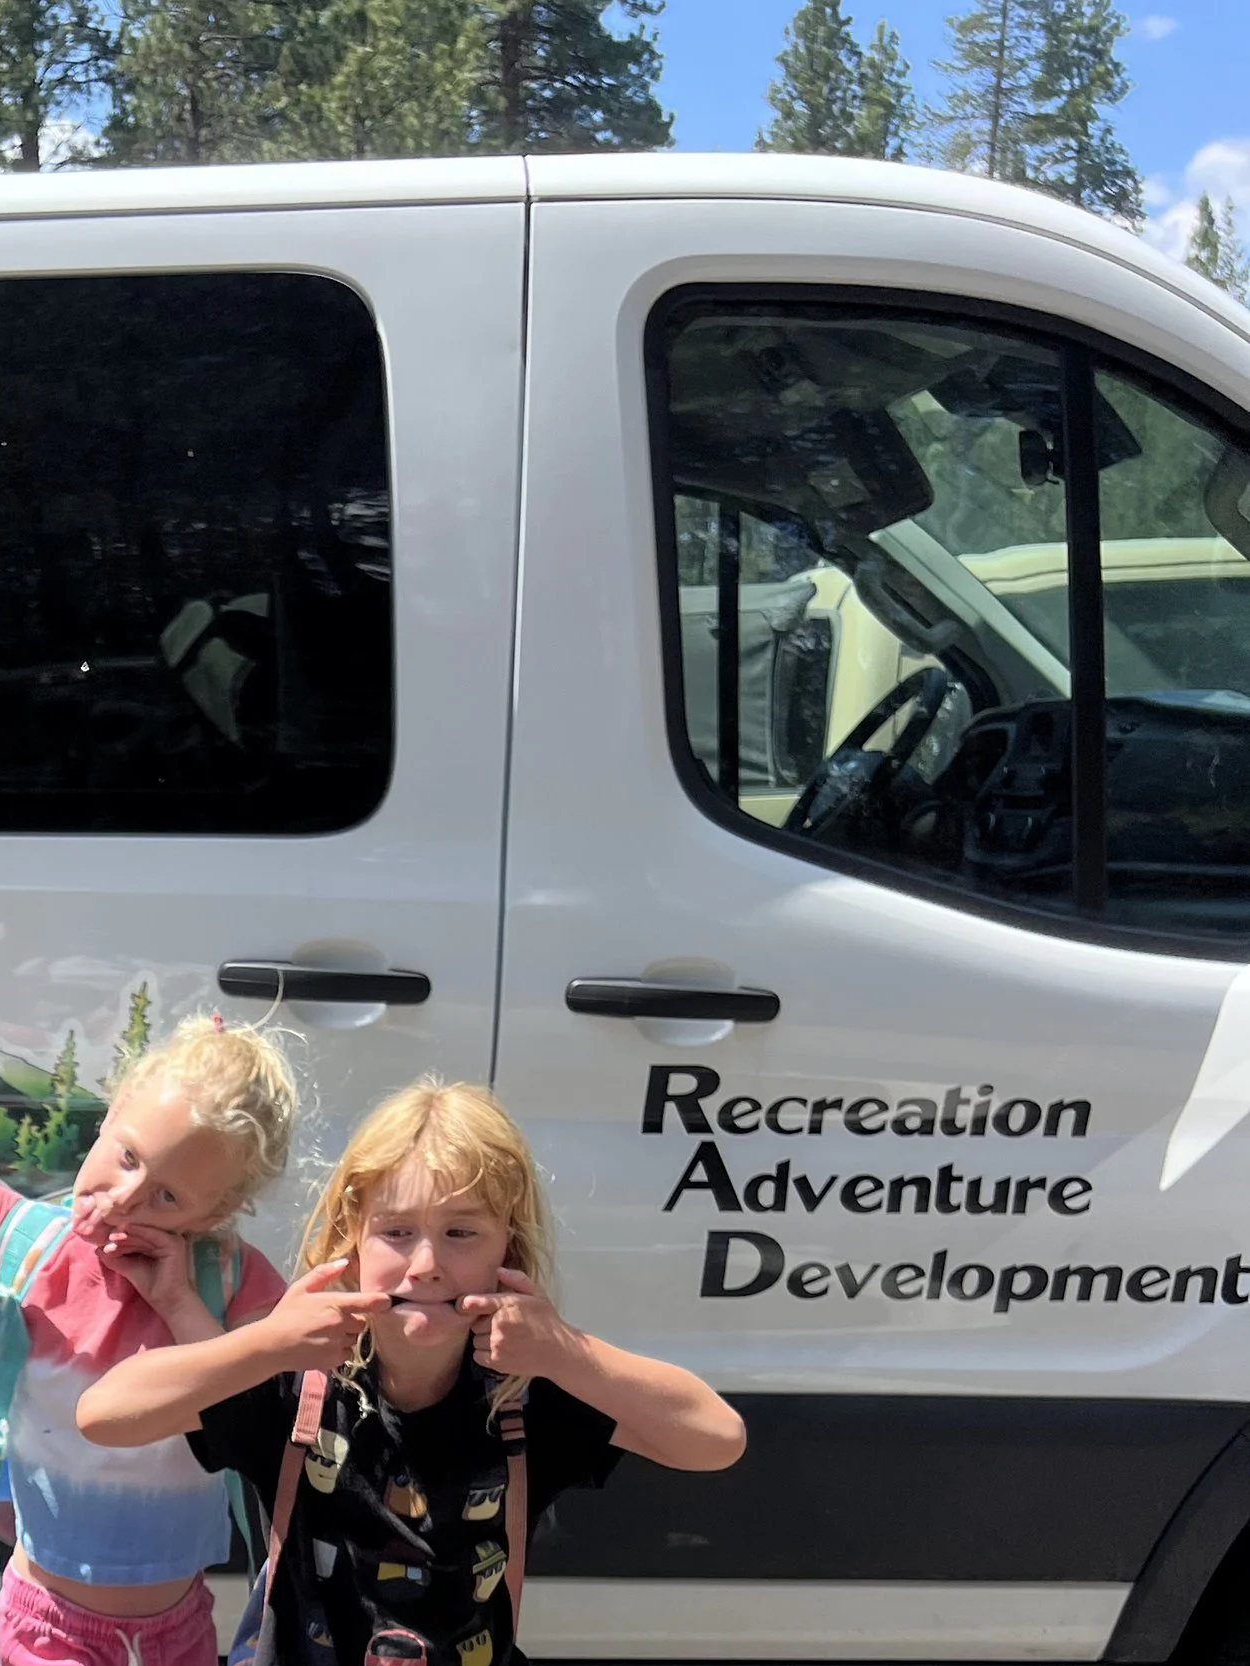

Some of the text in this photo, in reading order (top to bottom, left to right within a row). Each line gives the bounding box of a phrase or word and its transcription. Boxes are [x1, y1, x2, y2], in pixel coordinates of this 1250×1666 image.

[641, 1064, 1091, 1137] Recreation
[662, 1140, 1092, 1214] Adventure
[699, 1230, 1250, 1313] Development
